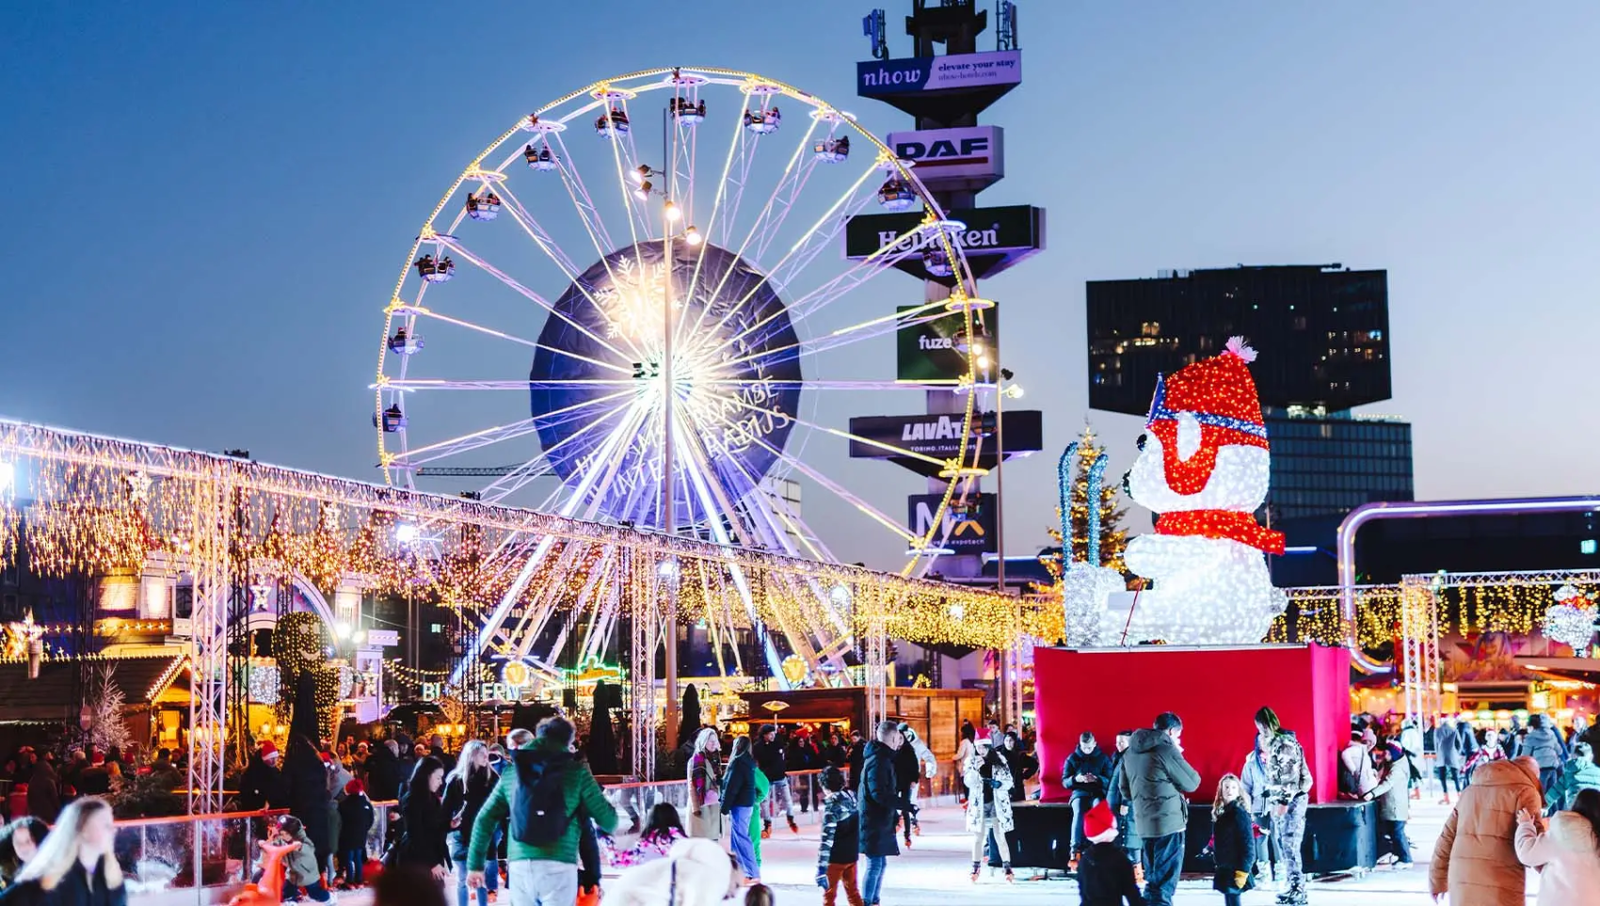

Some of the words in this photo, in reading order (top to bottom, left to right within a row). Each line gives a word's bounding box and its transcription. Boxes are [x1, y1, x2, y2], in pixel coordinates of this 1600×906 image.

[938, 63, 971, 72] elevate
[972, 61, 994, 71] your
[996, 59, 1016, 69] stay
[863, 68, 921, 86] nhow
[896, 137, 989, 158] DAF
[918, 335, 952, 349] fuze
[902, 415, 976, 441] LAVAZ
